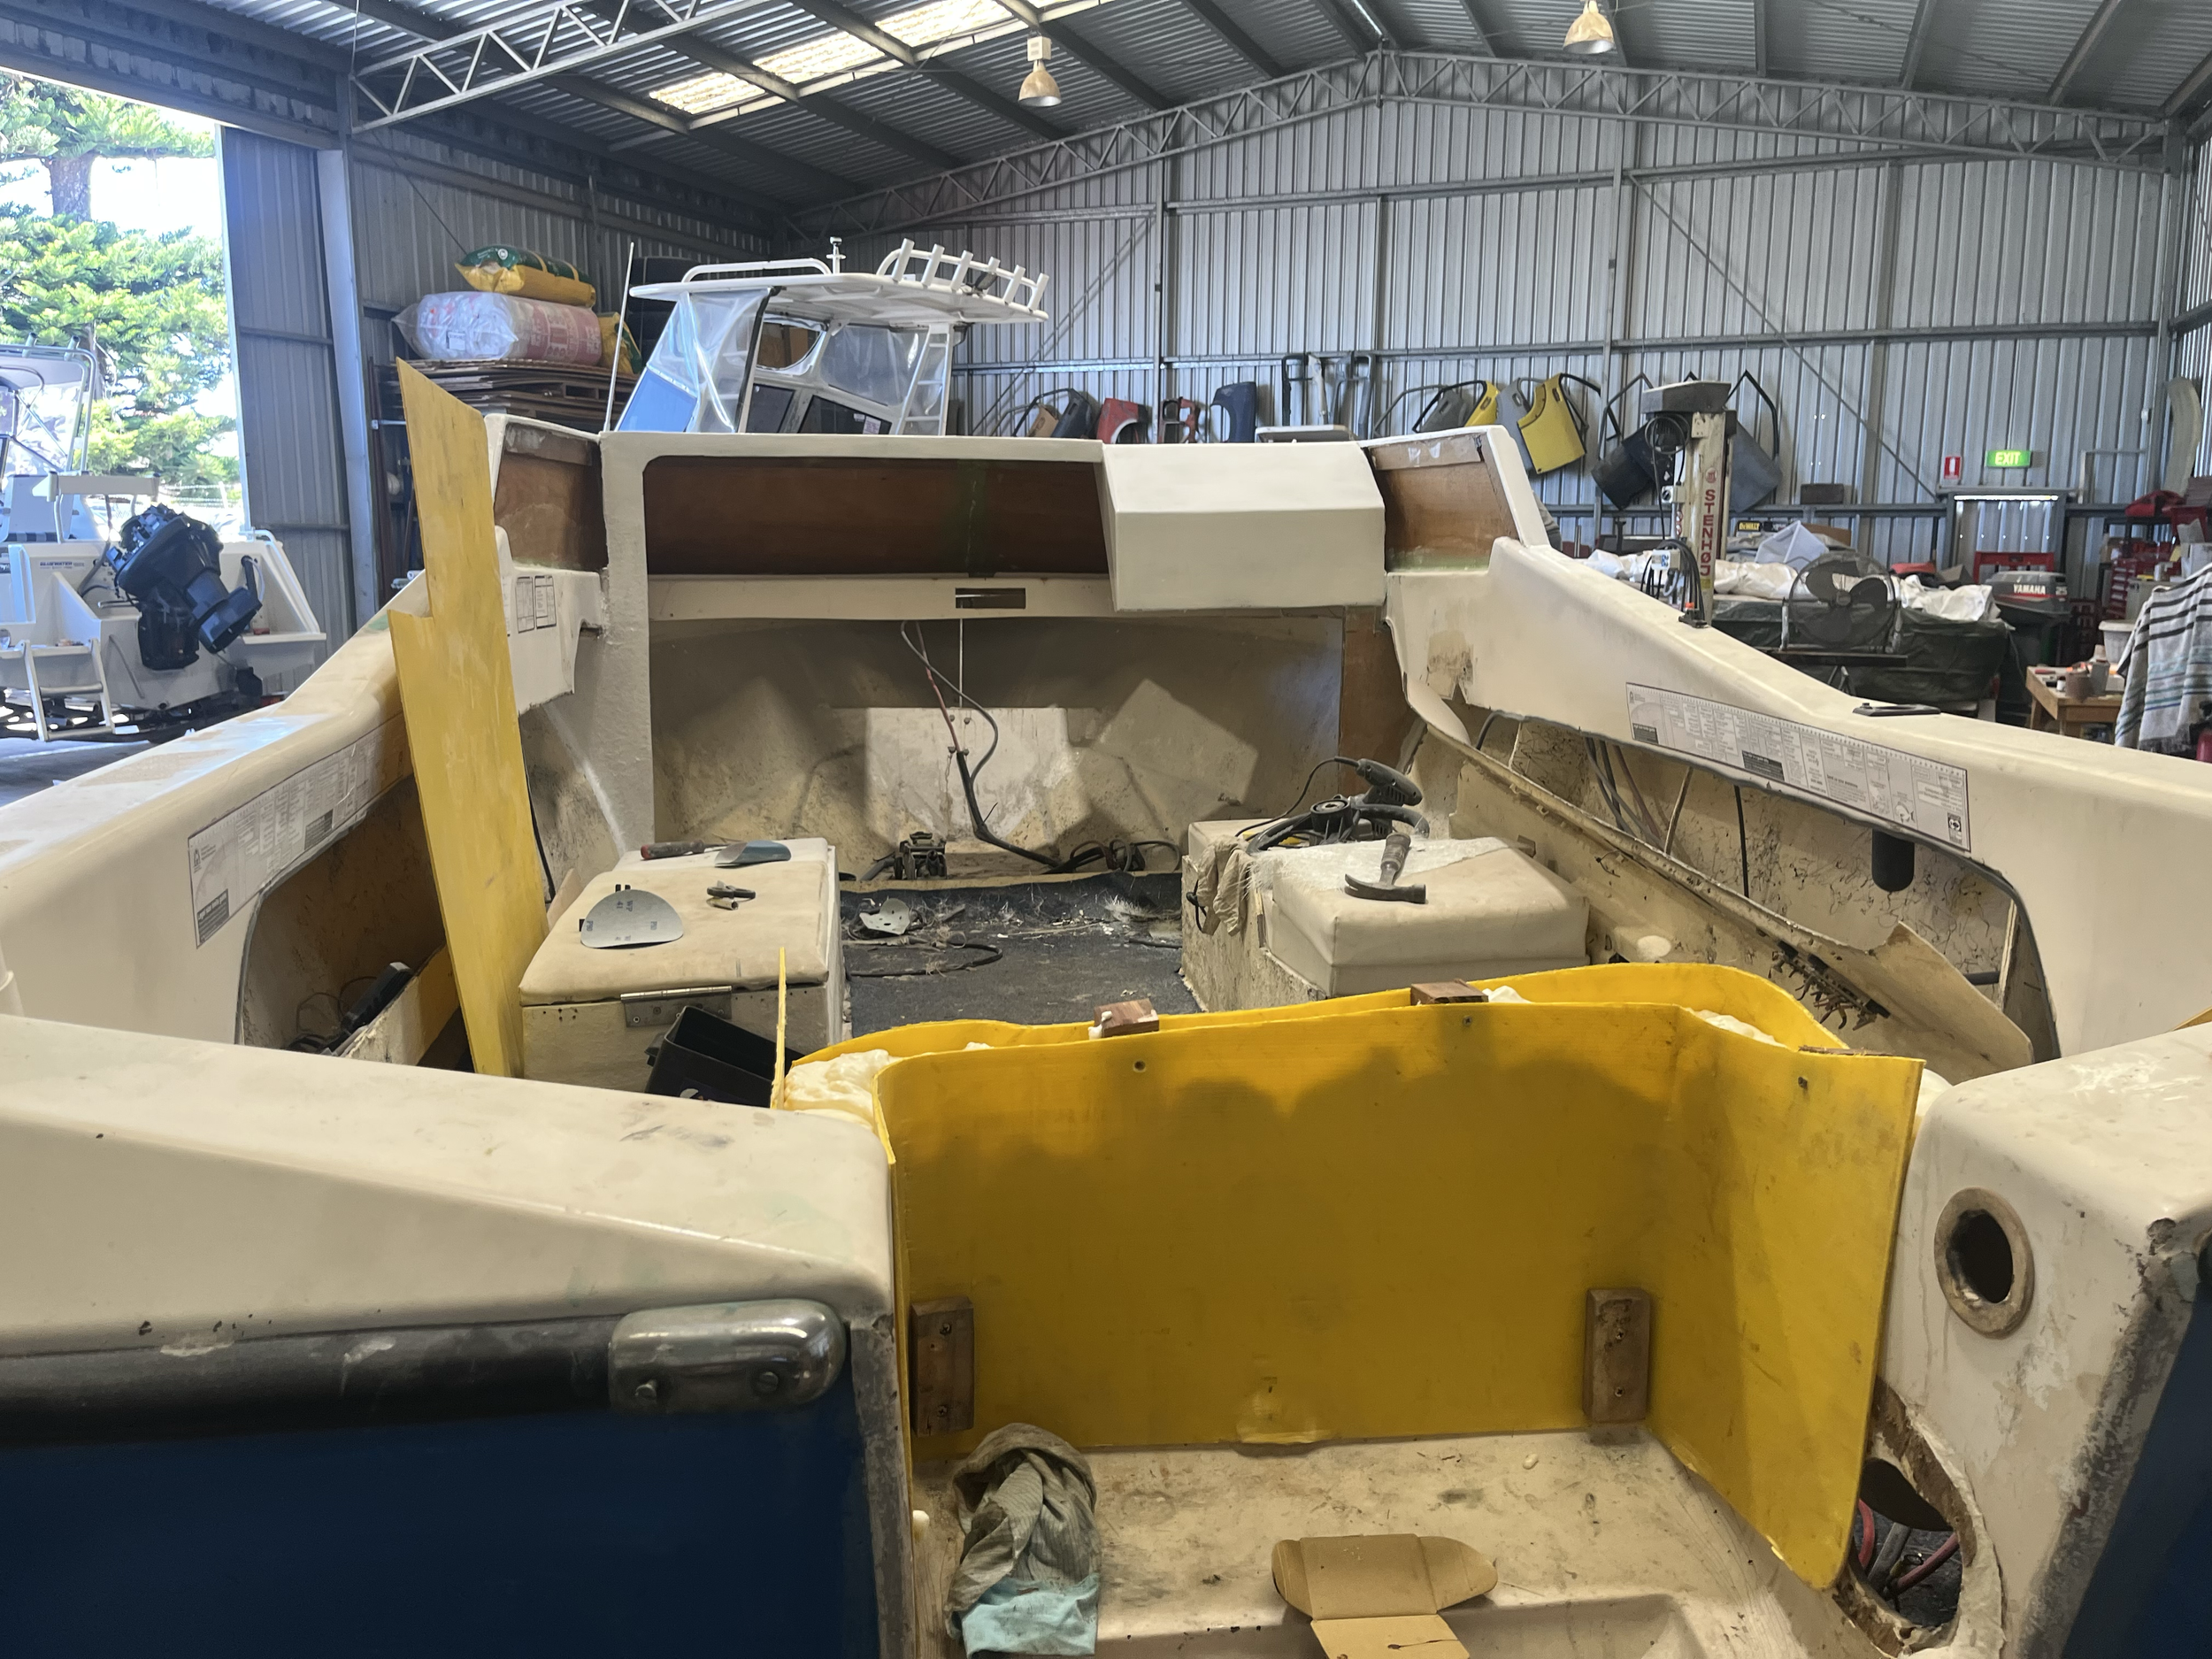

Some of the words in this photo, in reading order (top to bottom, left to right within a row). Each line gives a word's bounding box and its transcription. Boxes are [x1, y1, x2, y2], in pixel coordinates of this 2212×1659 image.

[1994, 451, 2022, 465] EXIT
[1700, 488, 1717, 577] STENHØJ
[2013, 583, 2047, 595] YAMAHA
